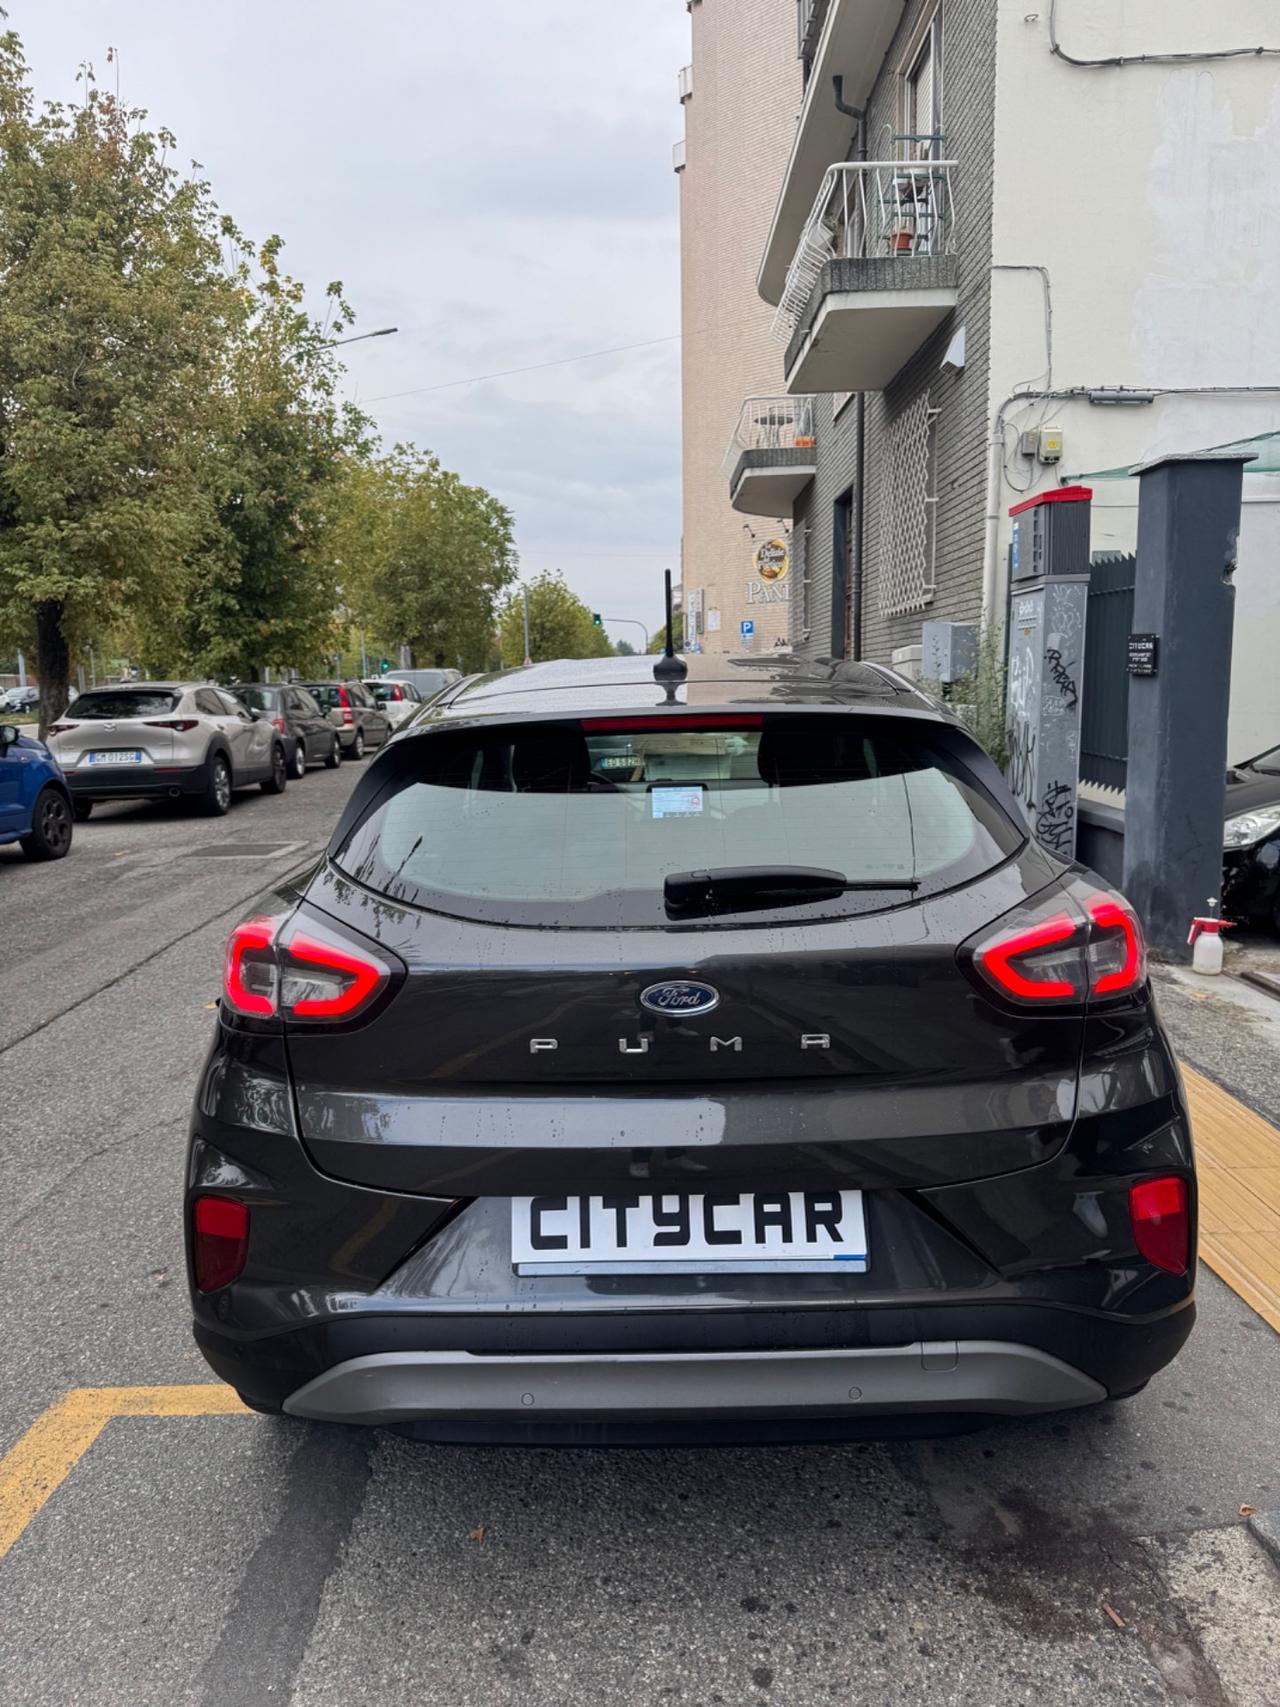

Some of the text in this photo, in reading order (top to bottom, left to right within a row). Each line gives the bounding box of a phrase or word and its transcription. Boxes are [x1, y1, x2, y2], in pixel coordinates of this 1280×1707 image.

[743, 622, 752, 633] P
[656, 985, 701, 1008] Ford
[529, 1033, 832, 1054] PUMA
[530, 1190, 845, 1250] CITYCAR
